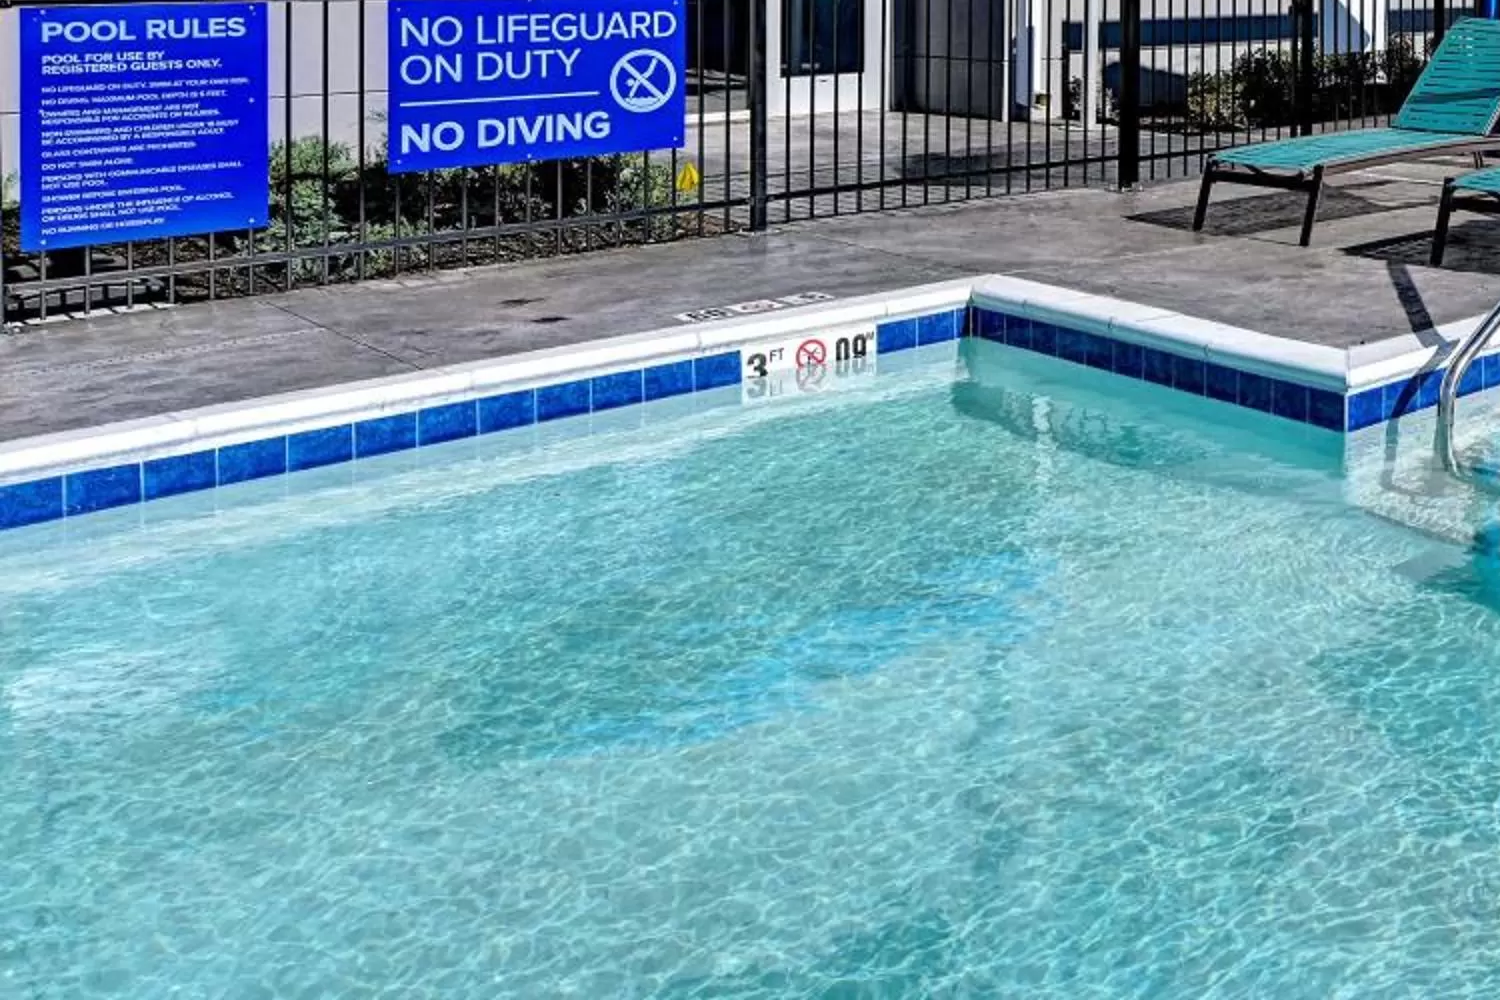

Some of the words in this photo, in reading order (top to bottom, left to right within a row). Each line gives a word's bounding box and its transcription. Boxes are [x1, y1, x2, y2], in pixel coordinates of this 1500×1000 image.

[41, 20, 136, 43] POOL
[146, 17, 247, 40] RULES
[400, 15, 463, 48] NO
[476, 10, 678, 45] LIFEGUARD
[41, 53, 81, 65] POOL
[84, 52, 113, 63] FOR
[116, 51, 145, 61] USE
[147, 50, 165, 61] BY
[41, 62, 127, 75] REGISTERED
[130, 60, 183, 71] GUESTS
[186, 58, 223, 69] ONLY.
[400, 53, 463, 86] ON
[476, 47, 582, 82] DUTY
[400, 120, 464, 155] NO
[477, 111, 611, 149] DIVING
[747, 353, 768, 378] 3
[769, 347, 784, 362] FT
